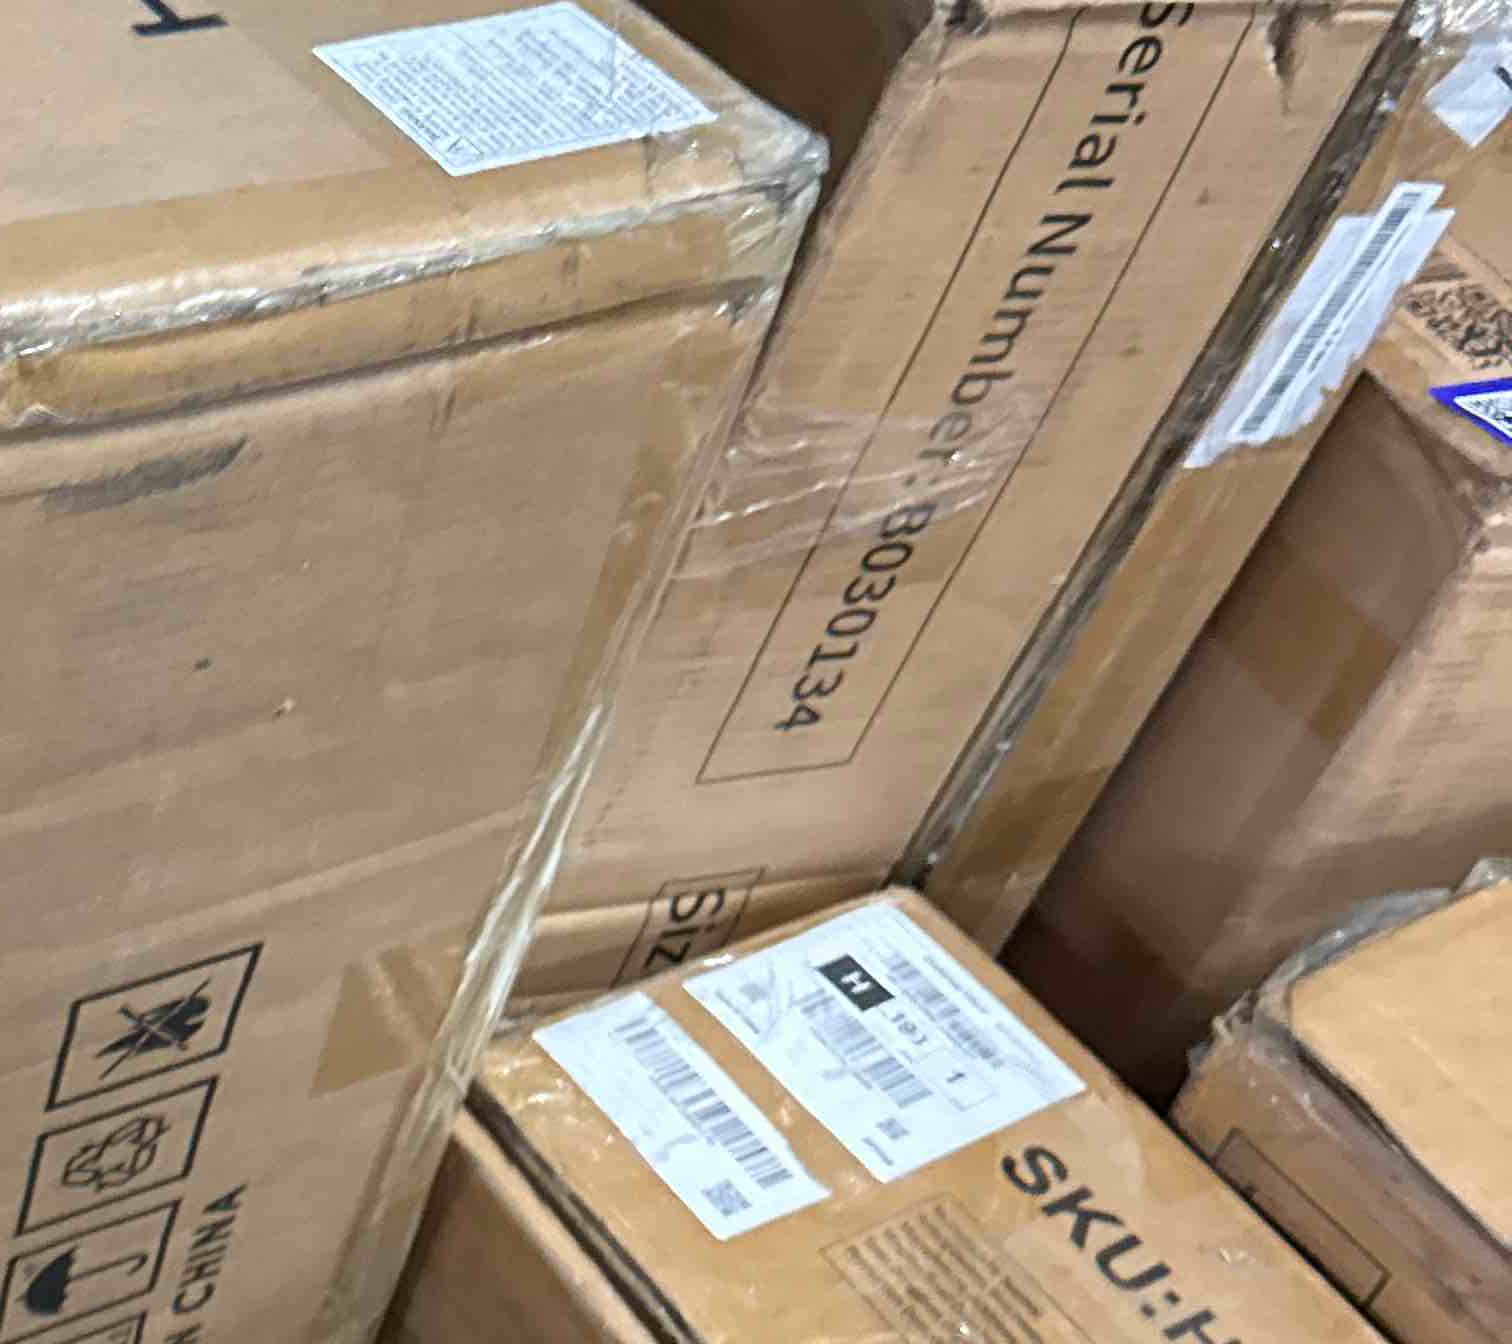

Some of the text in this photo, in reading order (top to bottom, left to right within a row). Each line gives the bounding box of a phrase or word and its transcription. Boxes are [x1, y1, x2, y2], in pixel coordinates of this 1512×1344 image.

[1054, 1, 1195, 194] Serial
[643, 888, 727, 970] Siz
[171, 1182, 249, 1315] CHINA
